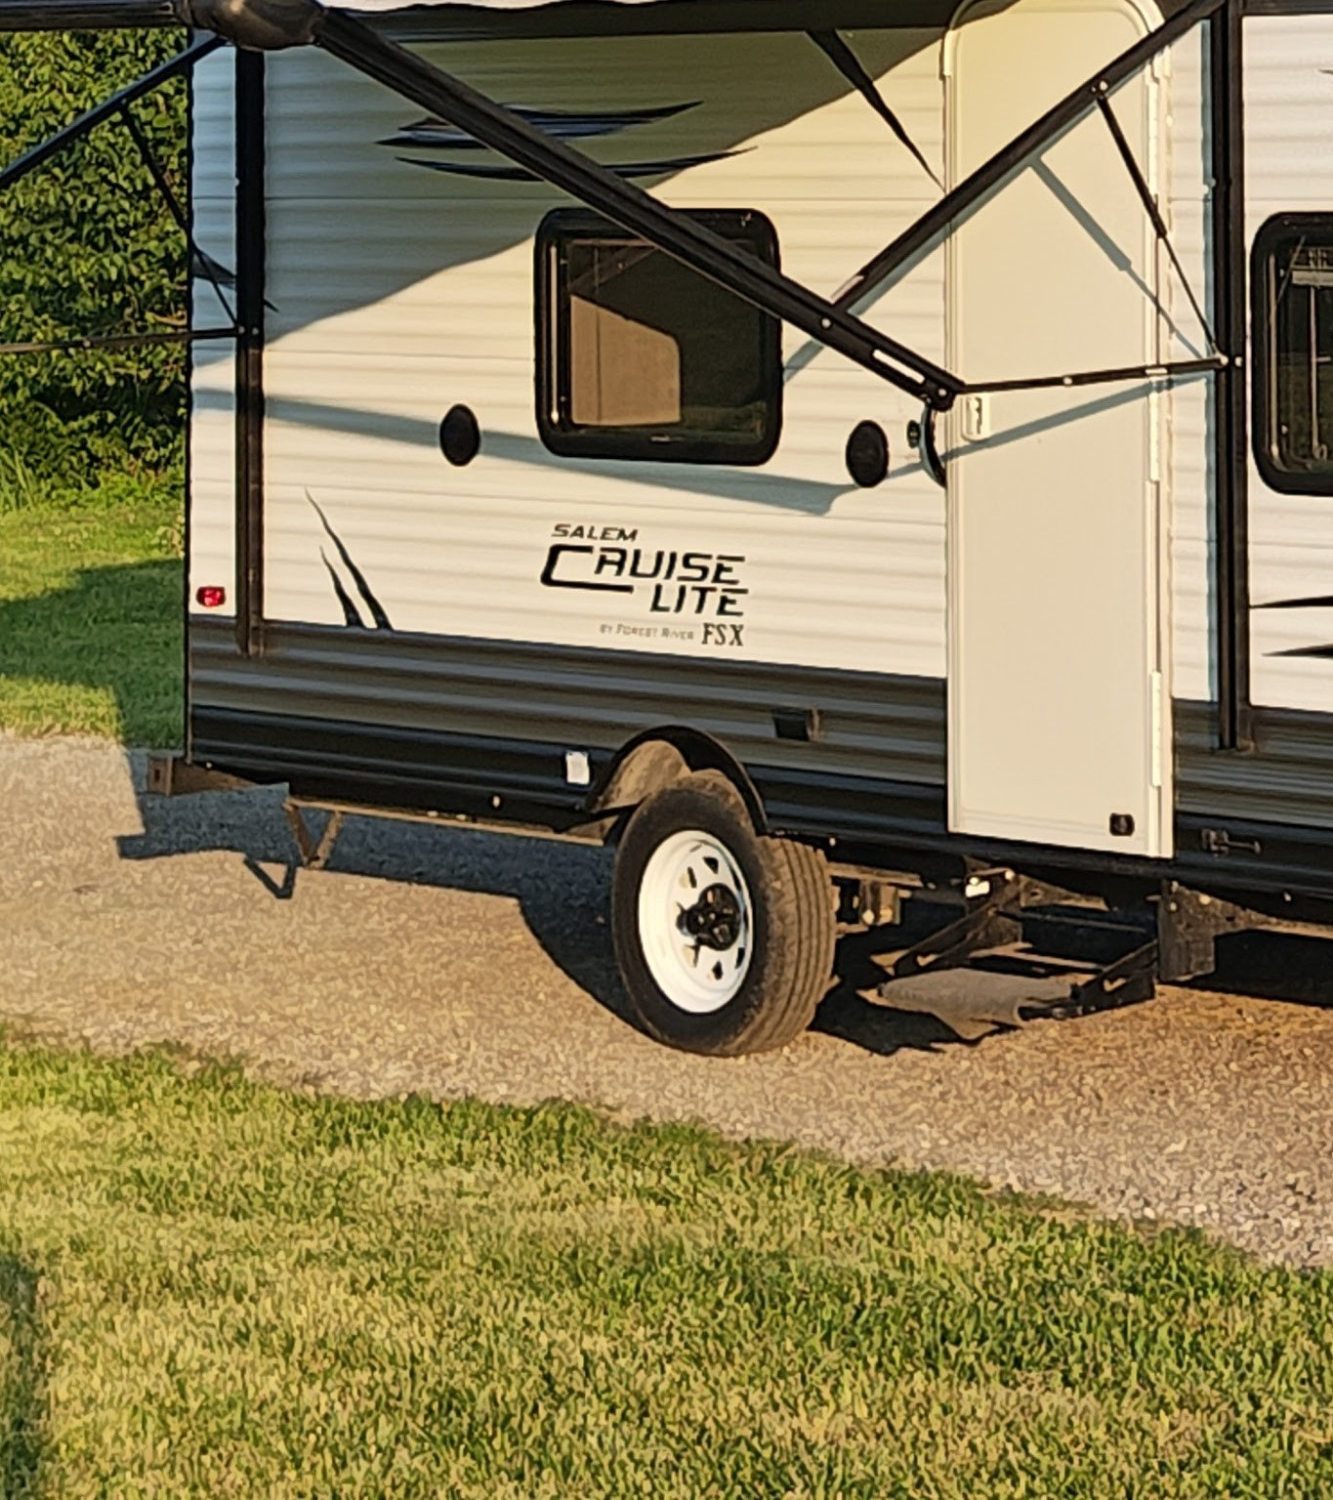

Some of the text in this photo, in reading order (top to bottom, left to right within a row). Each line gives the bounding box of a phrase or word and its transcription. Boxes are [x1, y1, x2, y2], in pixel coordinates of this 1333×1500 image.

[551, 523, 638, 542] SALEM
[540, 543, 745, 594] CRUISE
[650, 583, 748, 617] LITE
[701, 622, 744, 647] FSX
